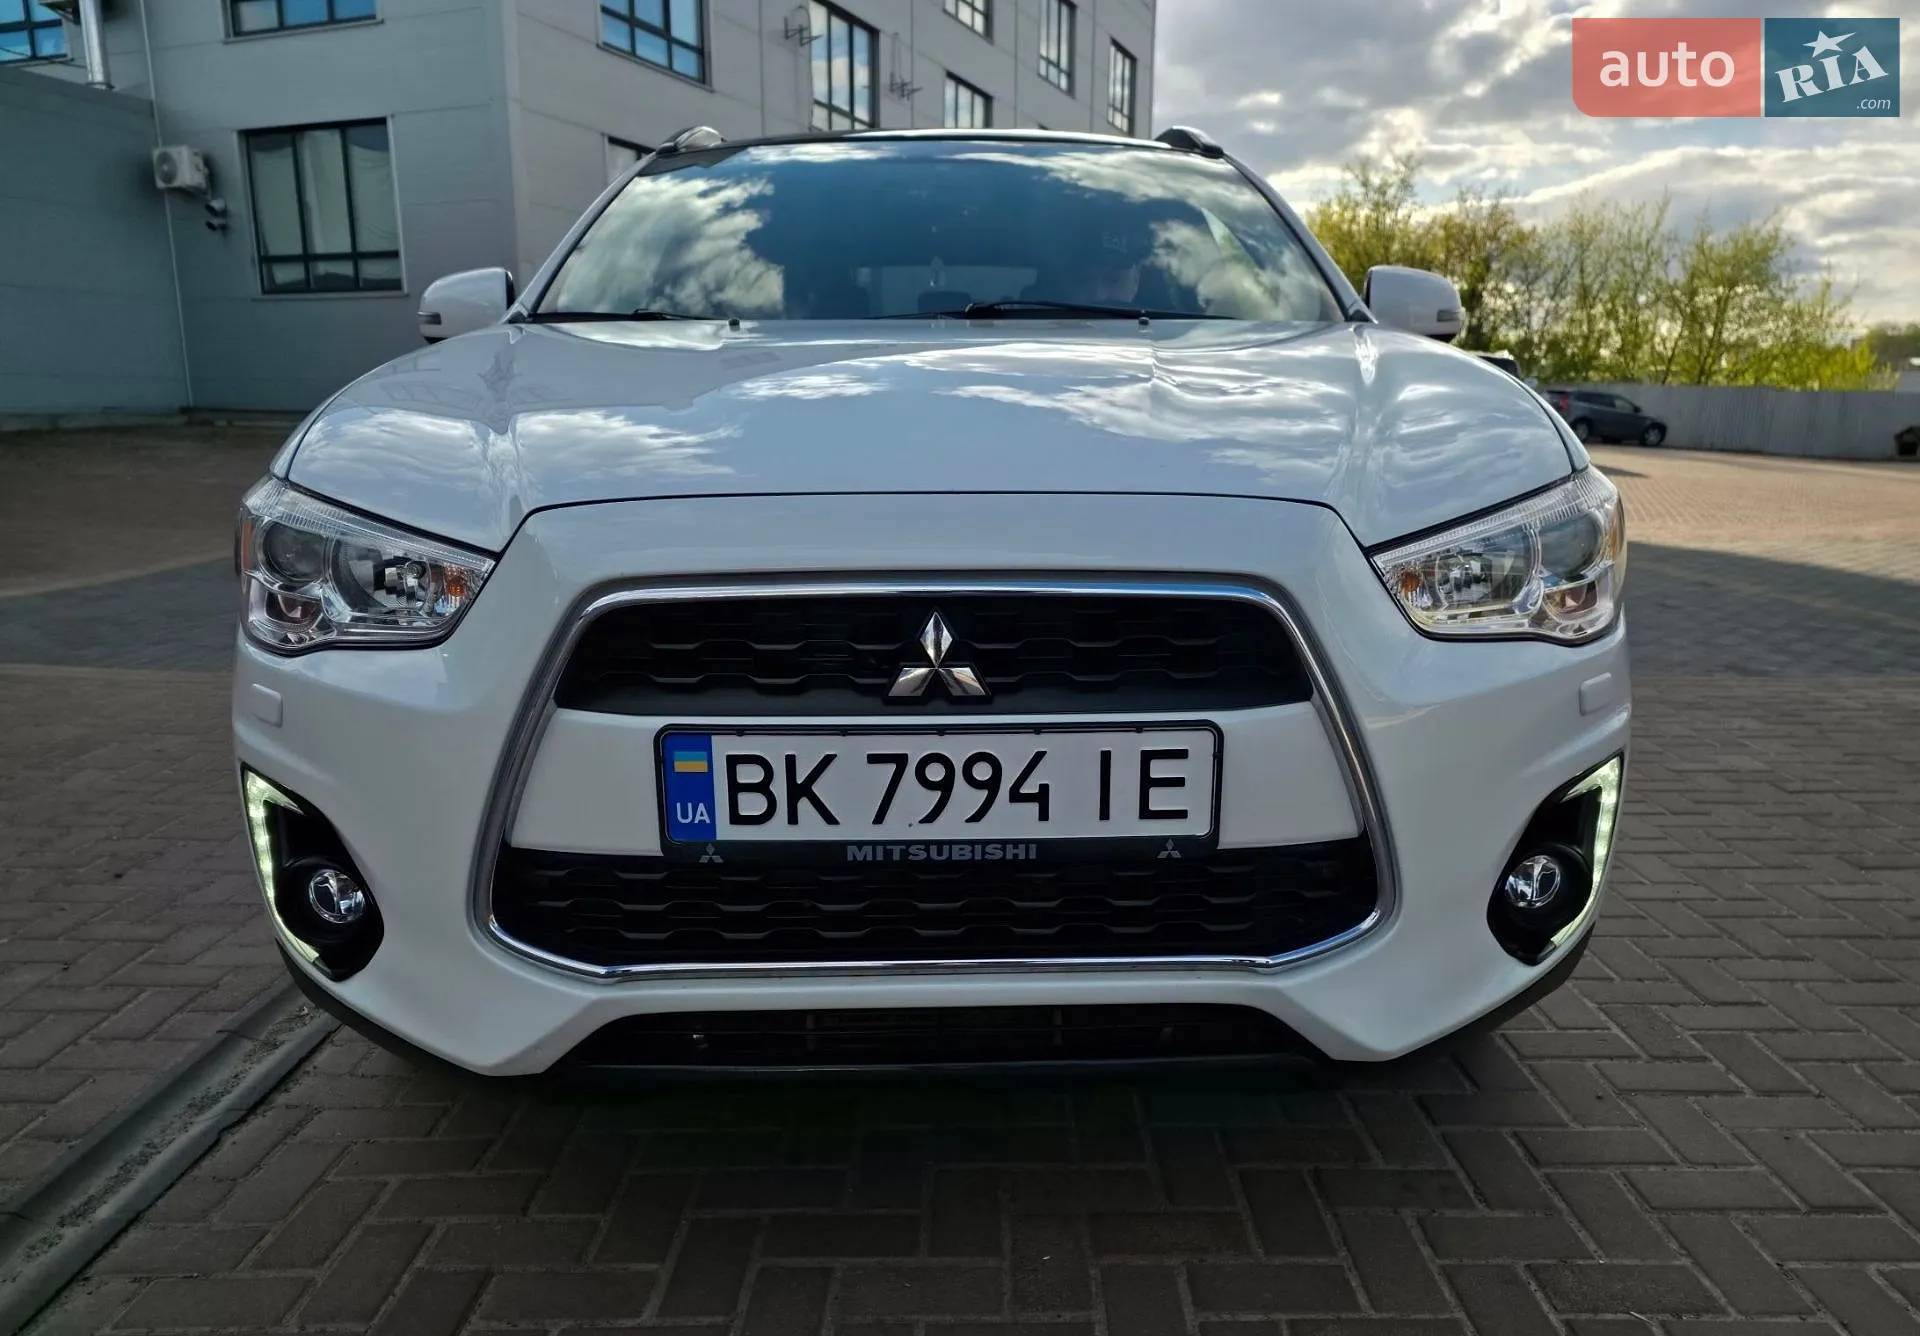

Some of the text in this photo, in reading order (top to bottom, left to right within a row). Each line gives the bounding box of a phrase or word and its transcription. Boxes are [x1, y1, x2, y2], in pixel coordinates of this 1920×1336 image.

[725, 748, 1189, 826] BK 7994 IE
[675, 802, 711, 825] UA
[846, 842, 1038, 862] MITSUBISHI
